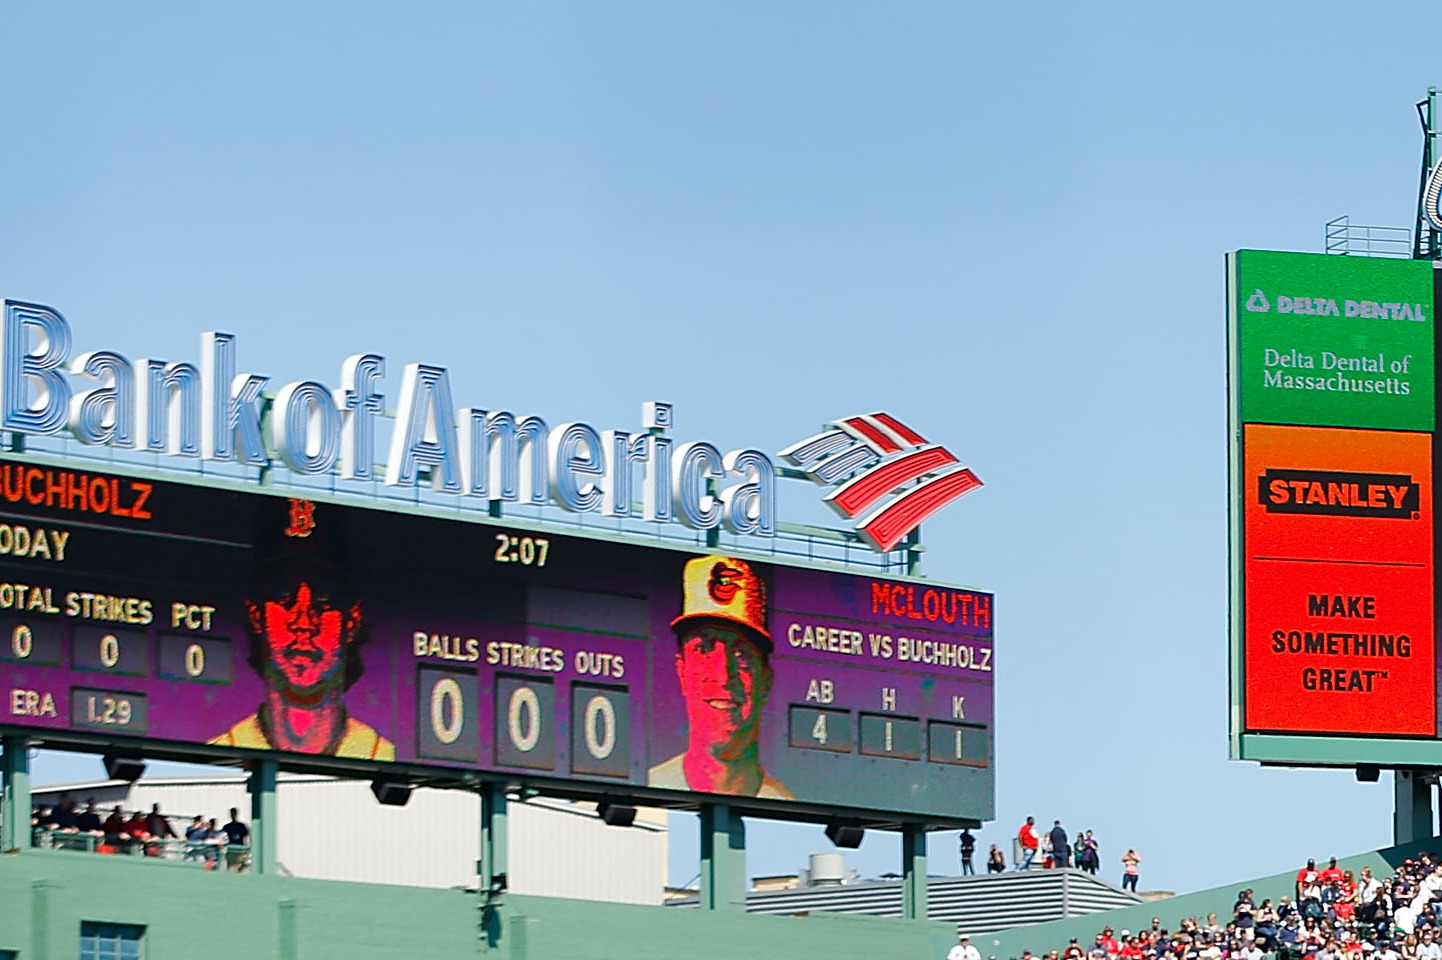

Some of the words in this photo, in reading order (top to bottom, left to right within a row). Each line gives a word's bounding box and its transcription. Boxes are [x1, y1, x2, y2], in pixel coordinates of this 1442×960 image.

[1277, 296, 1340, 317] DELTA
[1344, 300, 1426, 322] DENTAL
[1263, 348, 1315, 369] Delta
[1321, 351, 1385, 373] Dental
[1390, 355, 1412, 374] of
[1263, 369, 1411, 396] Massachusetts
[1, 297, 271, 468] Bank
[272, 353, 386, 482] of
[385, 362, 777, 537] America
[0, 464, 154, 520] UCHHOLZ
[1268, 479, 1409, 509] STANLEY
[493, 533, 549, 568] 2:07
[66, 590, 154, 625] STRIKES
[171, 602, 216, 631] PCT
[871, 583, 991, 629] MCLOUTH
[1308, 594, 1376, 619] MAKE
[11, 624, 33, 659] 0
[100, 633, 120, 668] 0
[185, 644, 206, 677] 0
[413, 631, 480, 663] BALLS
[486, 640, 565, 674] STRIKES
[574, 649, 625, 679] OUTS
[787, 623, 863, 657] CAREER
[868, 632, 894, 659] VS
[897, 637, 993, 672] BUCHHOLZ
[1272, 630, 1411, 658] SOMETHING
[9, 688, 58, 718] ERA
[86, 695, 132, 726] 1.29
[429, 677, 464, 745] 0
[507, 686, 542, 753] 0
[584, 695, 617, 761] 0
[805, 679, 835, 706] AB
[882, 687, 896, 713] H
[952, 696, 965, 720] K
[811, 714, 828, 745] 4
